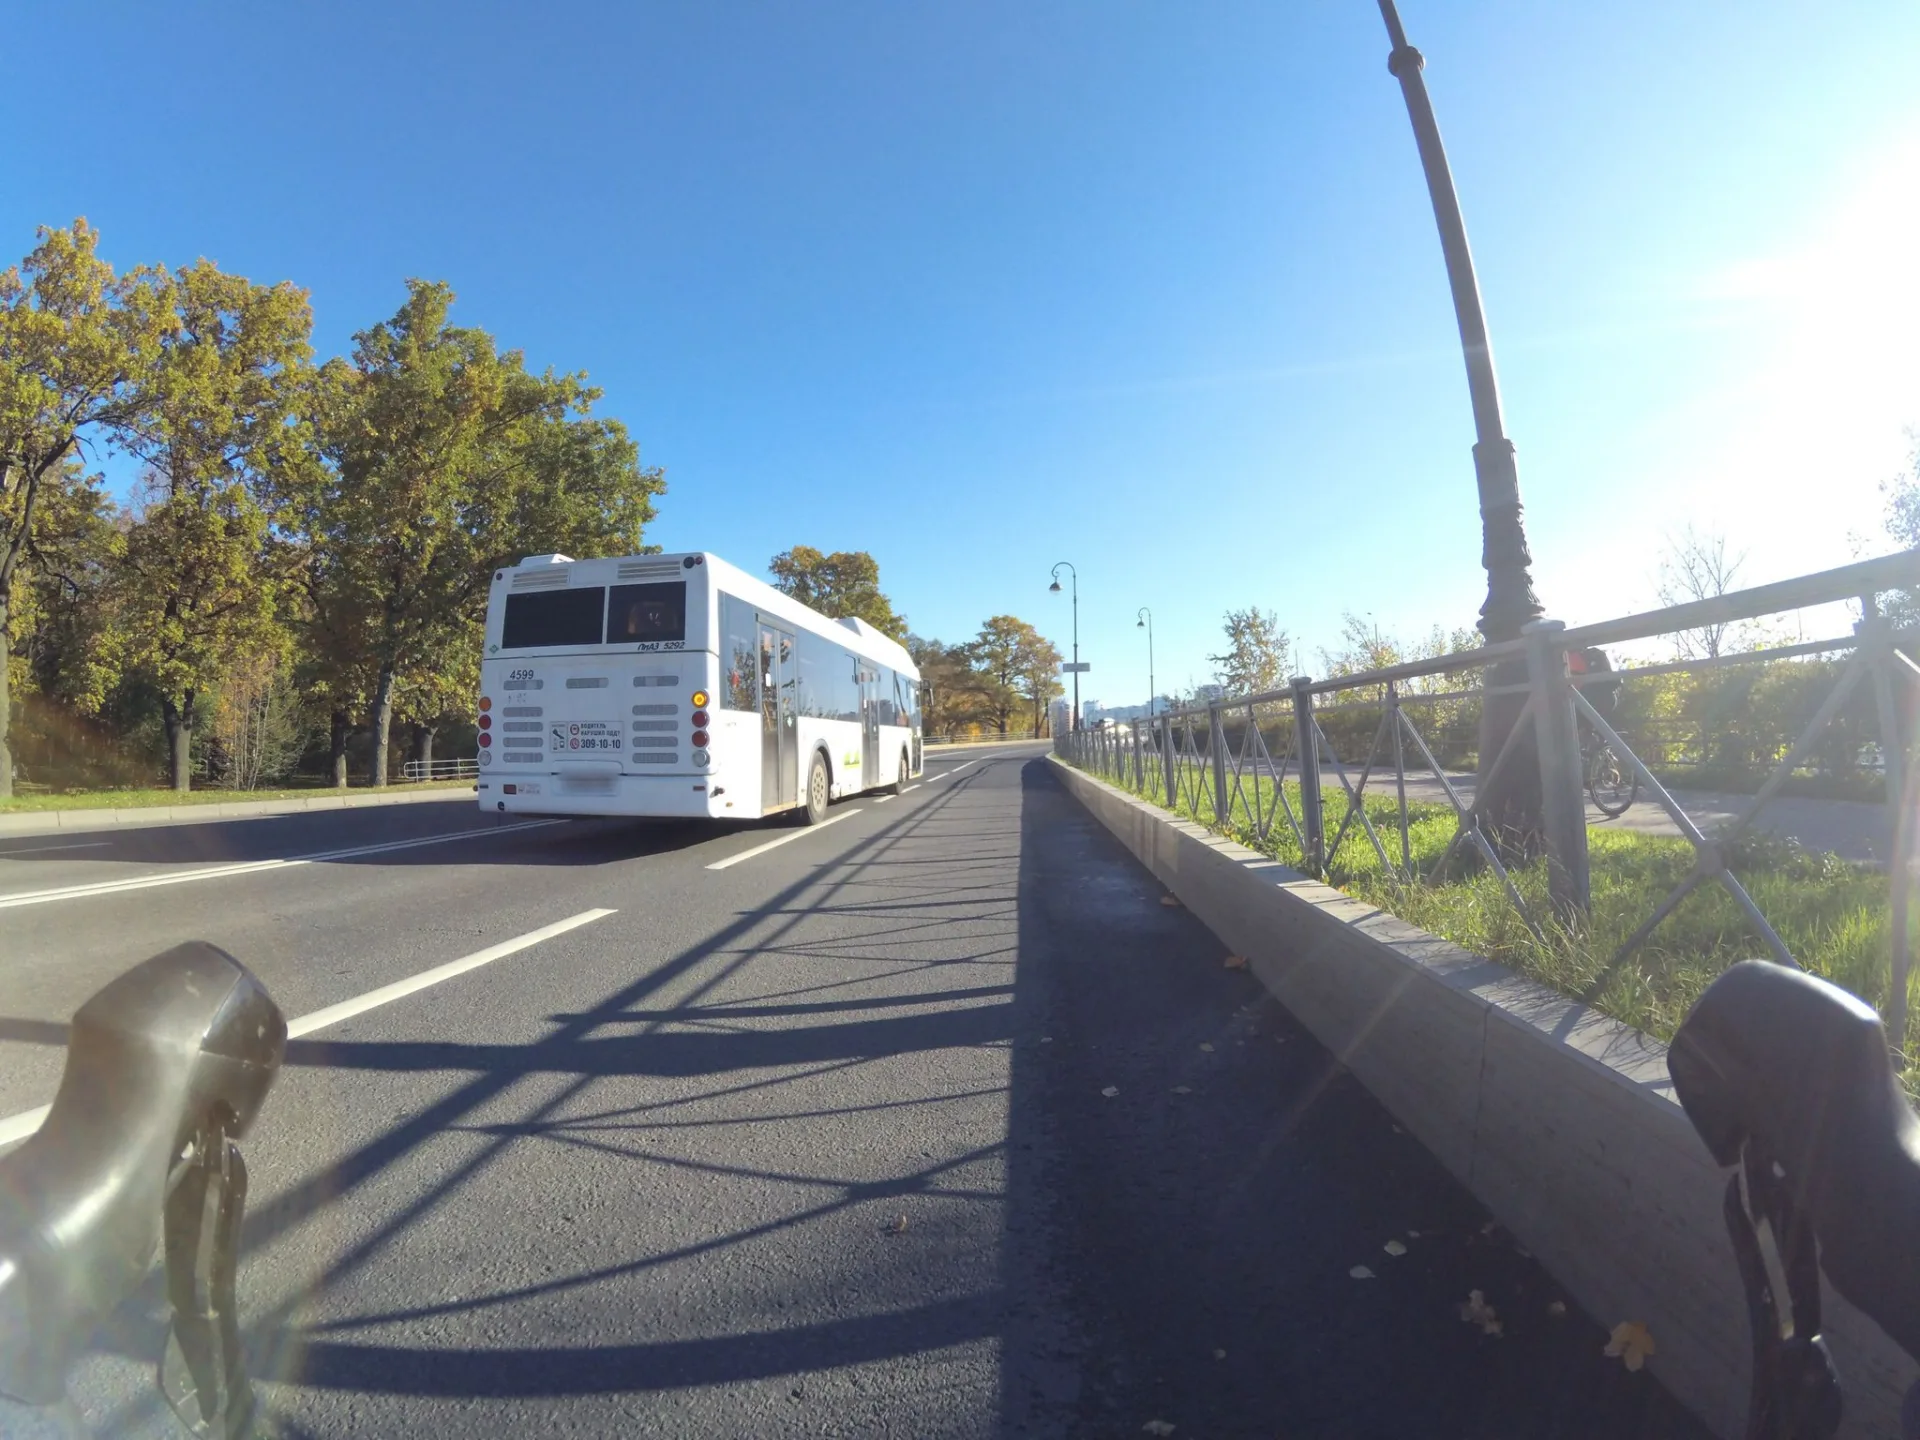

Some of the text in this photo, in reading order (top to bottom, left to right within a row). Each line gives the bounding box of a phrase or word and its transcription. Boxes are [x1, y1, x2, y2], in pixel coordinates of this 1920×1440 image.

[663, 641, 686, 650] 5292
[509, 669, 534, 680] 4599
[580, 739, 621, 749] 309-10-10
